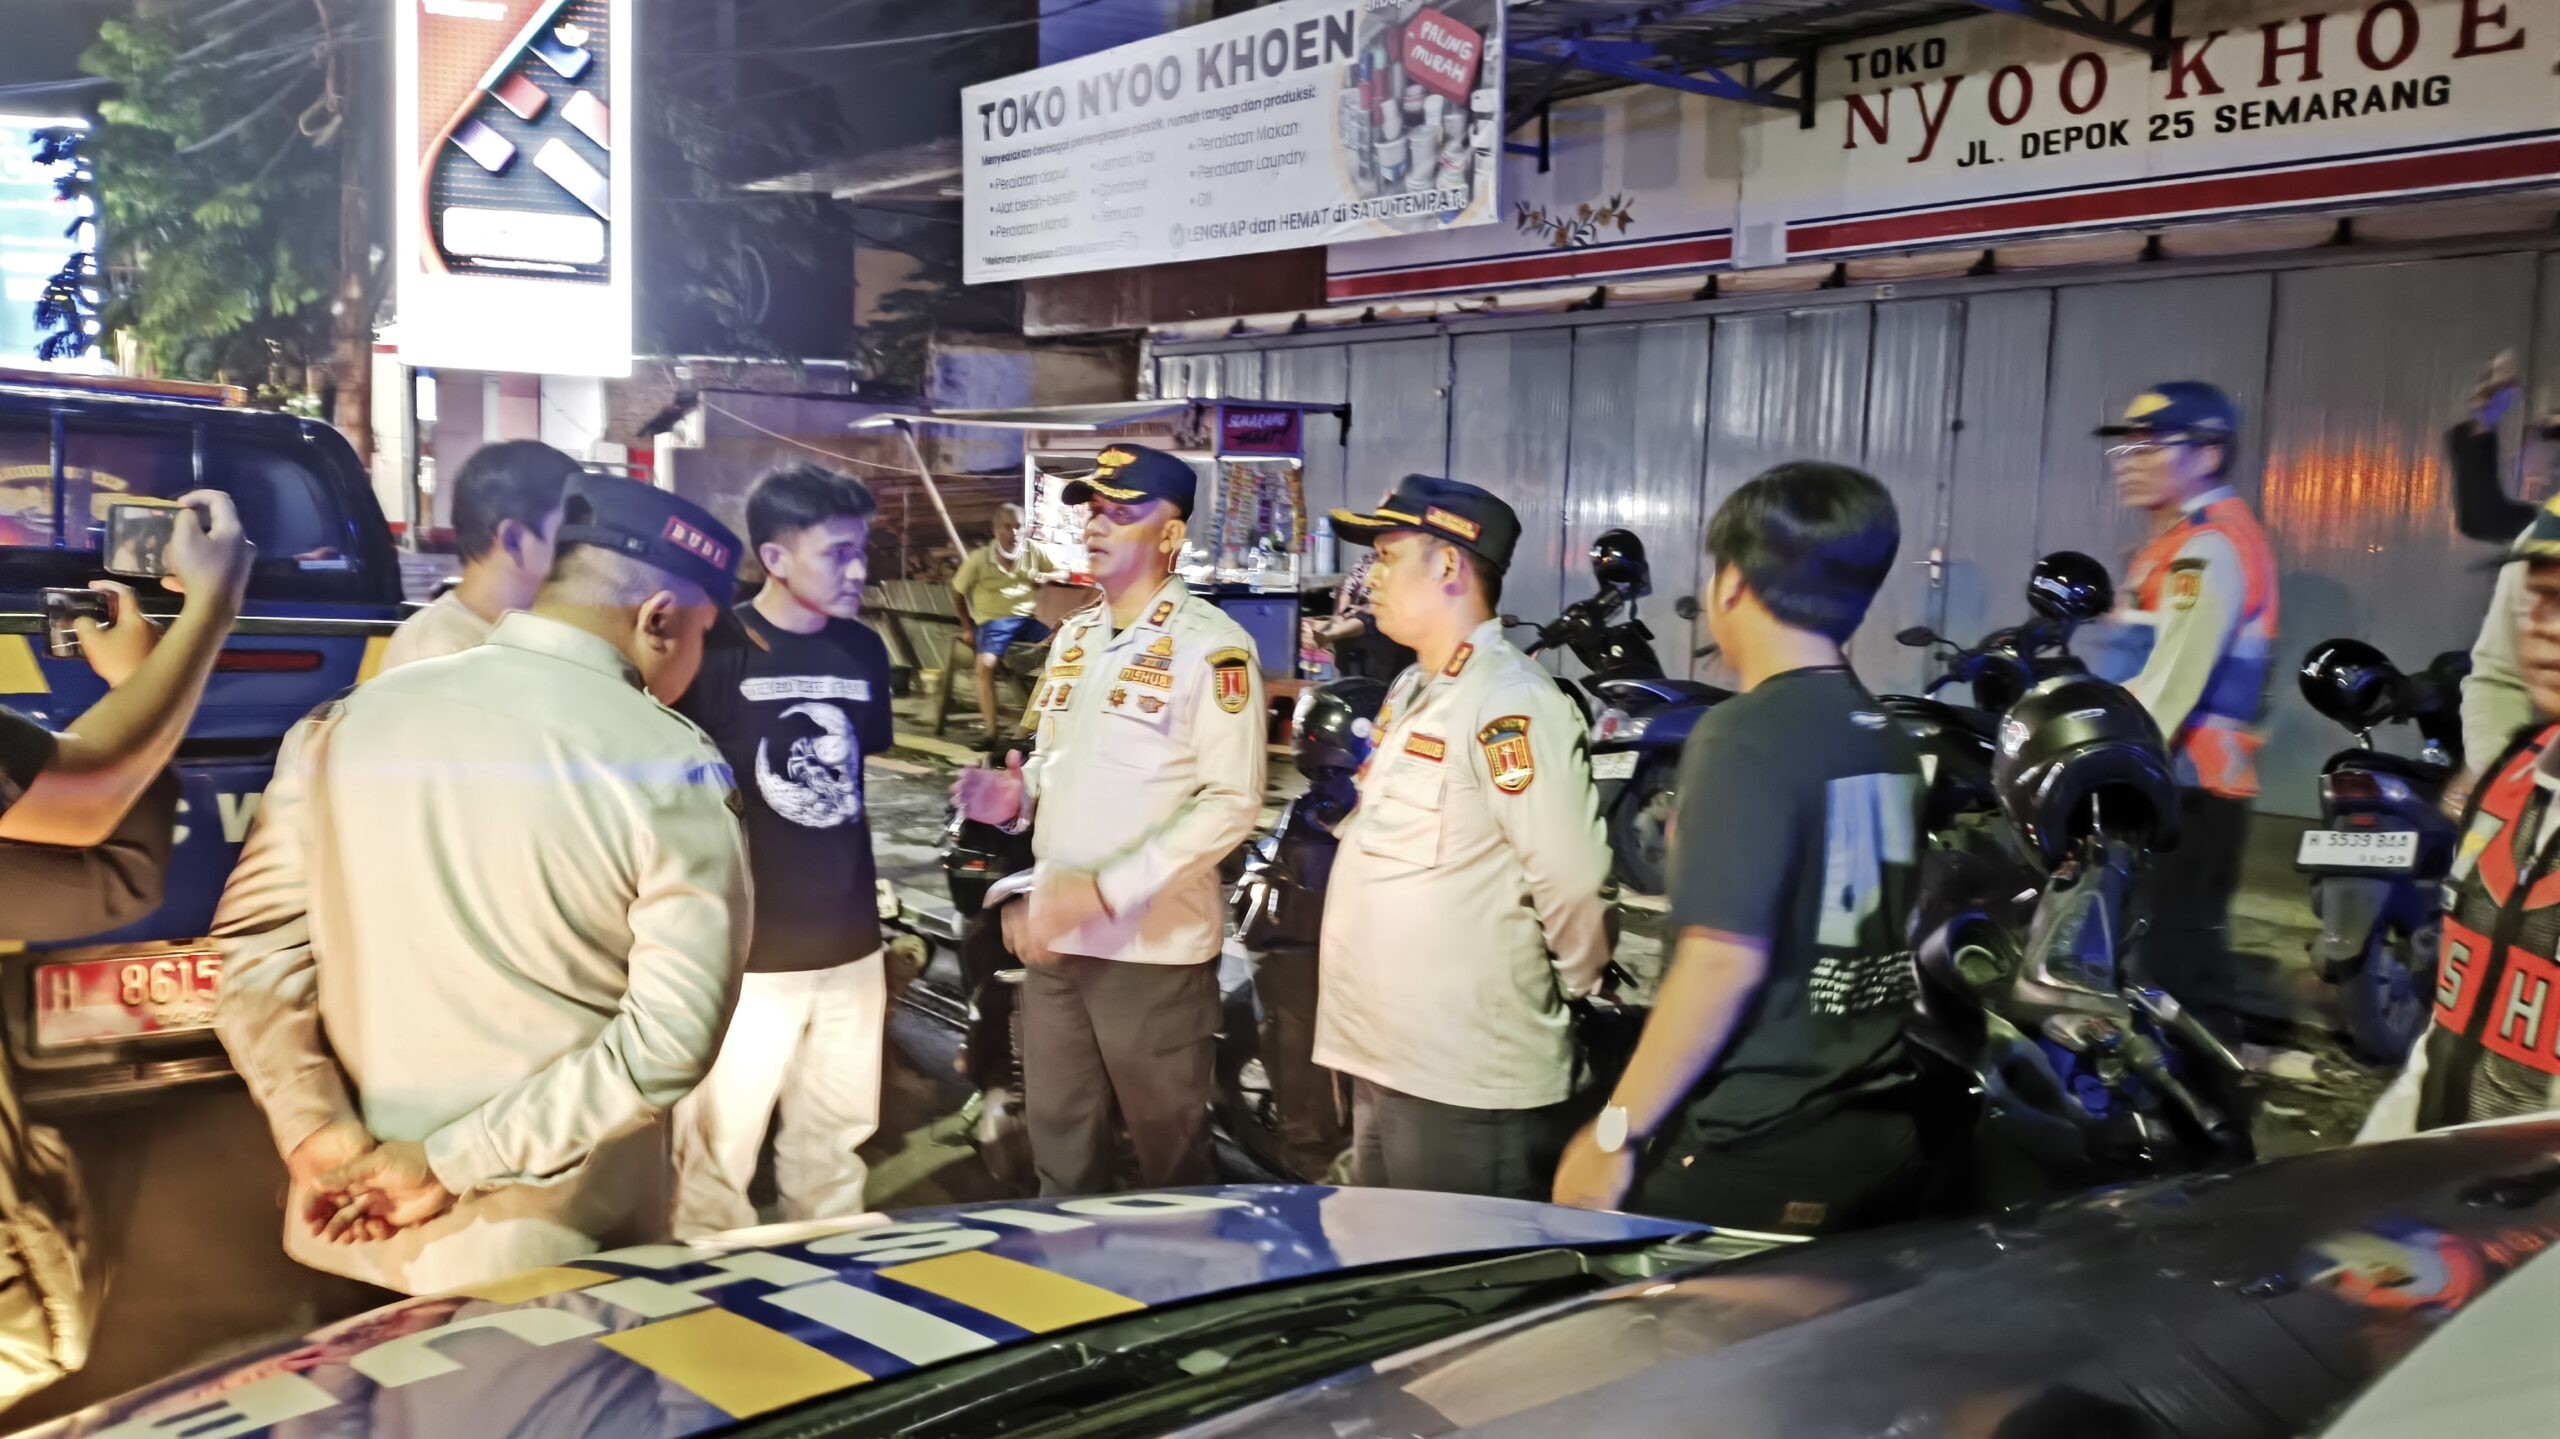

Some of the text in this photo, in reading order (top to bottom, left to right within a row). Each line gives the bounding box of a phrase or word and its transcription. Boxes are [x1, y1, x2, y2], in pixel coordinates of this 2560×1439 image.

[1420, 20, 1473, 60] PALING
[977, 10, 1355, 141] TOKO NYOO KHOEN
[1410, 45, 1468, 83] MURAH
[1845, 37, 1947, 83] TOKO
[1167, 111, 1200, 127] rumah
[1201, 106, 1239, 121] tangga
[1240, 99, 1261, 112] dan
[1957, 75, 2452, 168] JL. DEPOK 25 SEMARANG
[1196, 121, 1299, 151] Peralatan Makan
[995, 173, 1038, 191] Peralatan
[1197, 149, 1307, 179] Peralatan Laundry
[995, 199, 1014, 214] Alat
[1187, 220, 1246, 242] LENGKAP
[1249, 217, 1276, 235] dan
[1279, 207, 1329, 230] HEMAT
[1333, 206, 1346, 223] di
[1350, 199, 1389, 220] SATU
[995, 222, 1039, 238] Peralatan
[51, 970, 81, 1013] H
